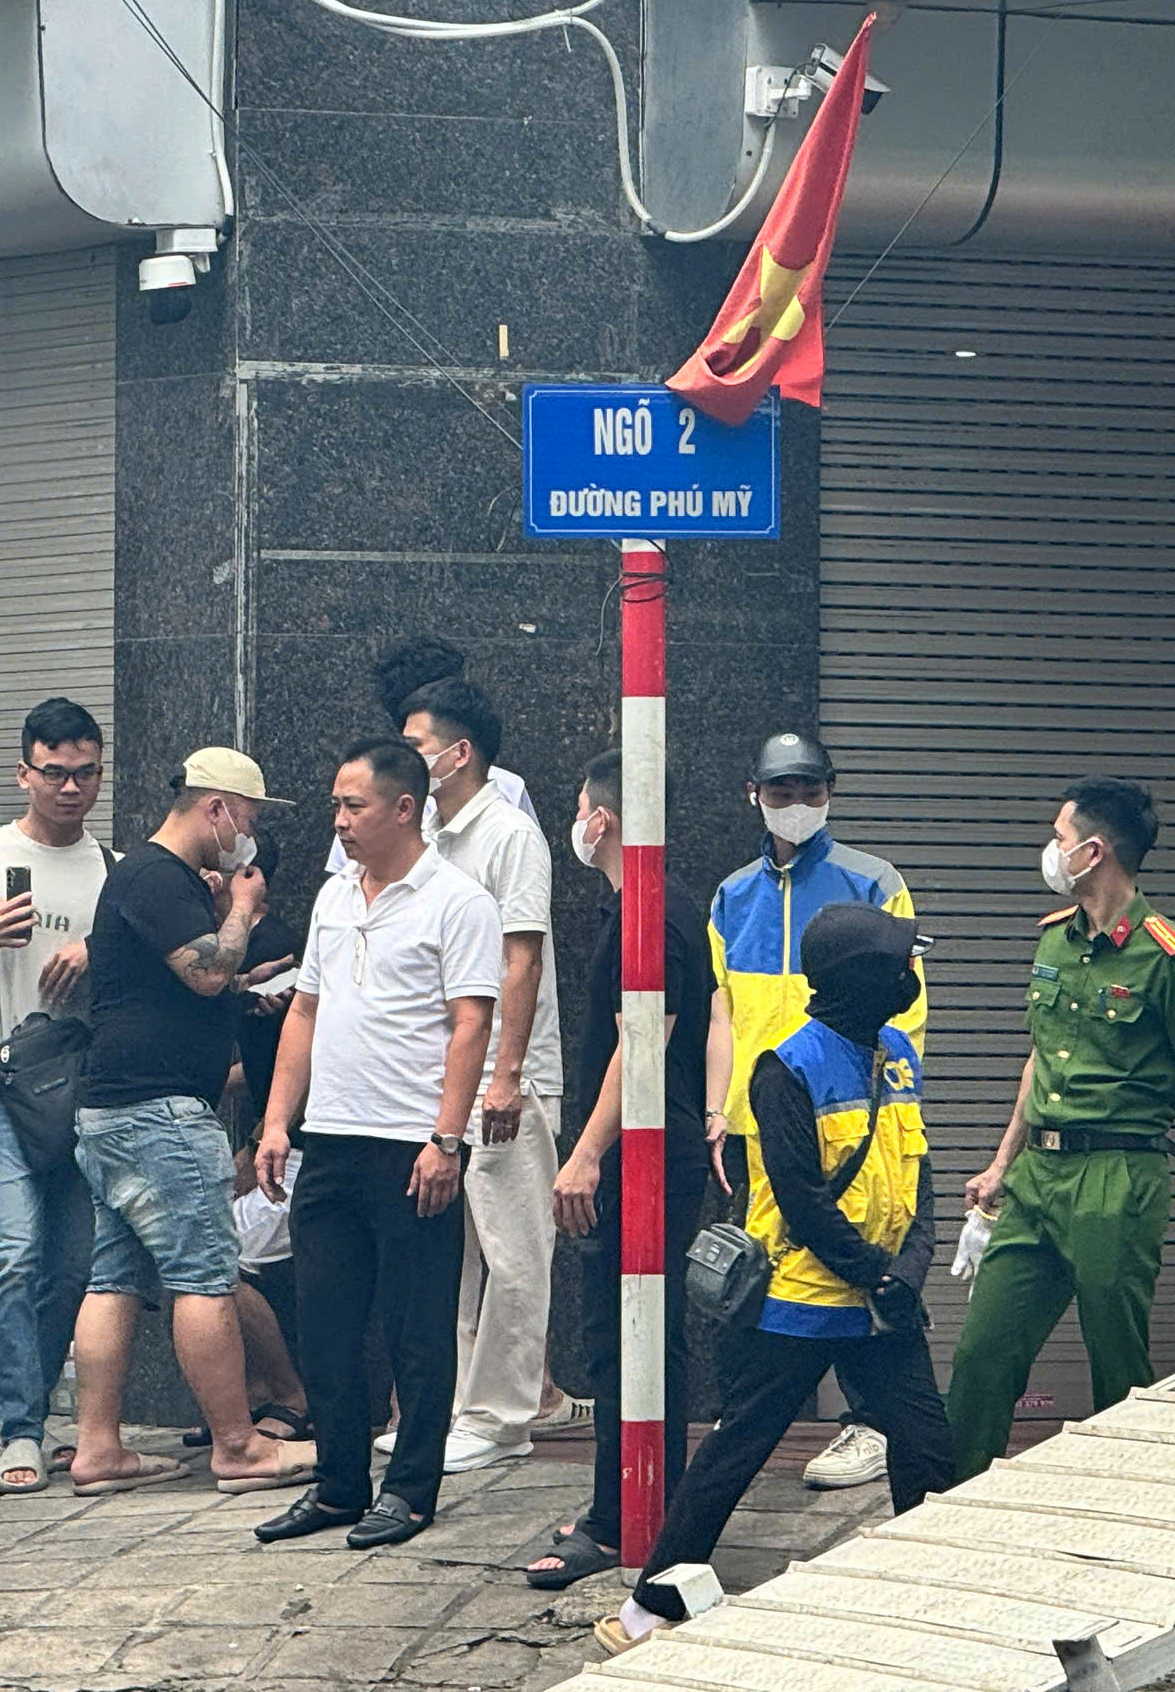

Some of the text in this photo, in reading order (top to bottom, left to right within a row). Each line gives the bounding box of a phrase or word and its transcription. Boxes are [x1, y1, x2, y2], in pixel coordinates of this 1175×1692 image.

[593, 398, 696, 456] NGÕ 2
[549, 483, 754, 517] ĐƯỜNG PHÚ MỸ
